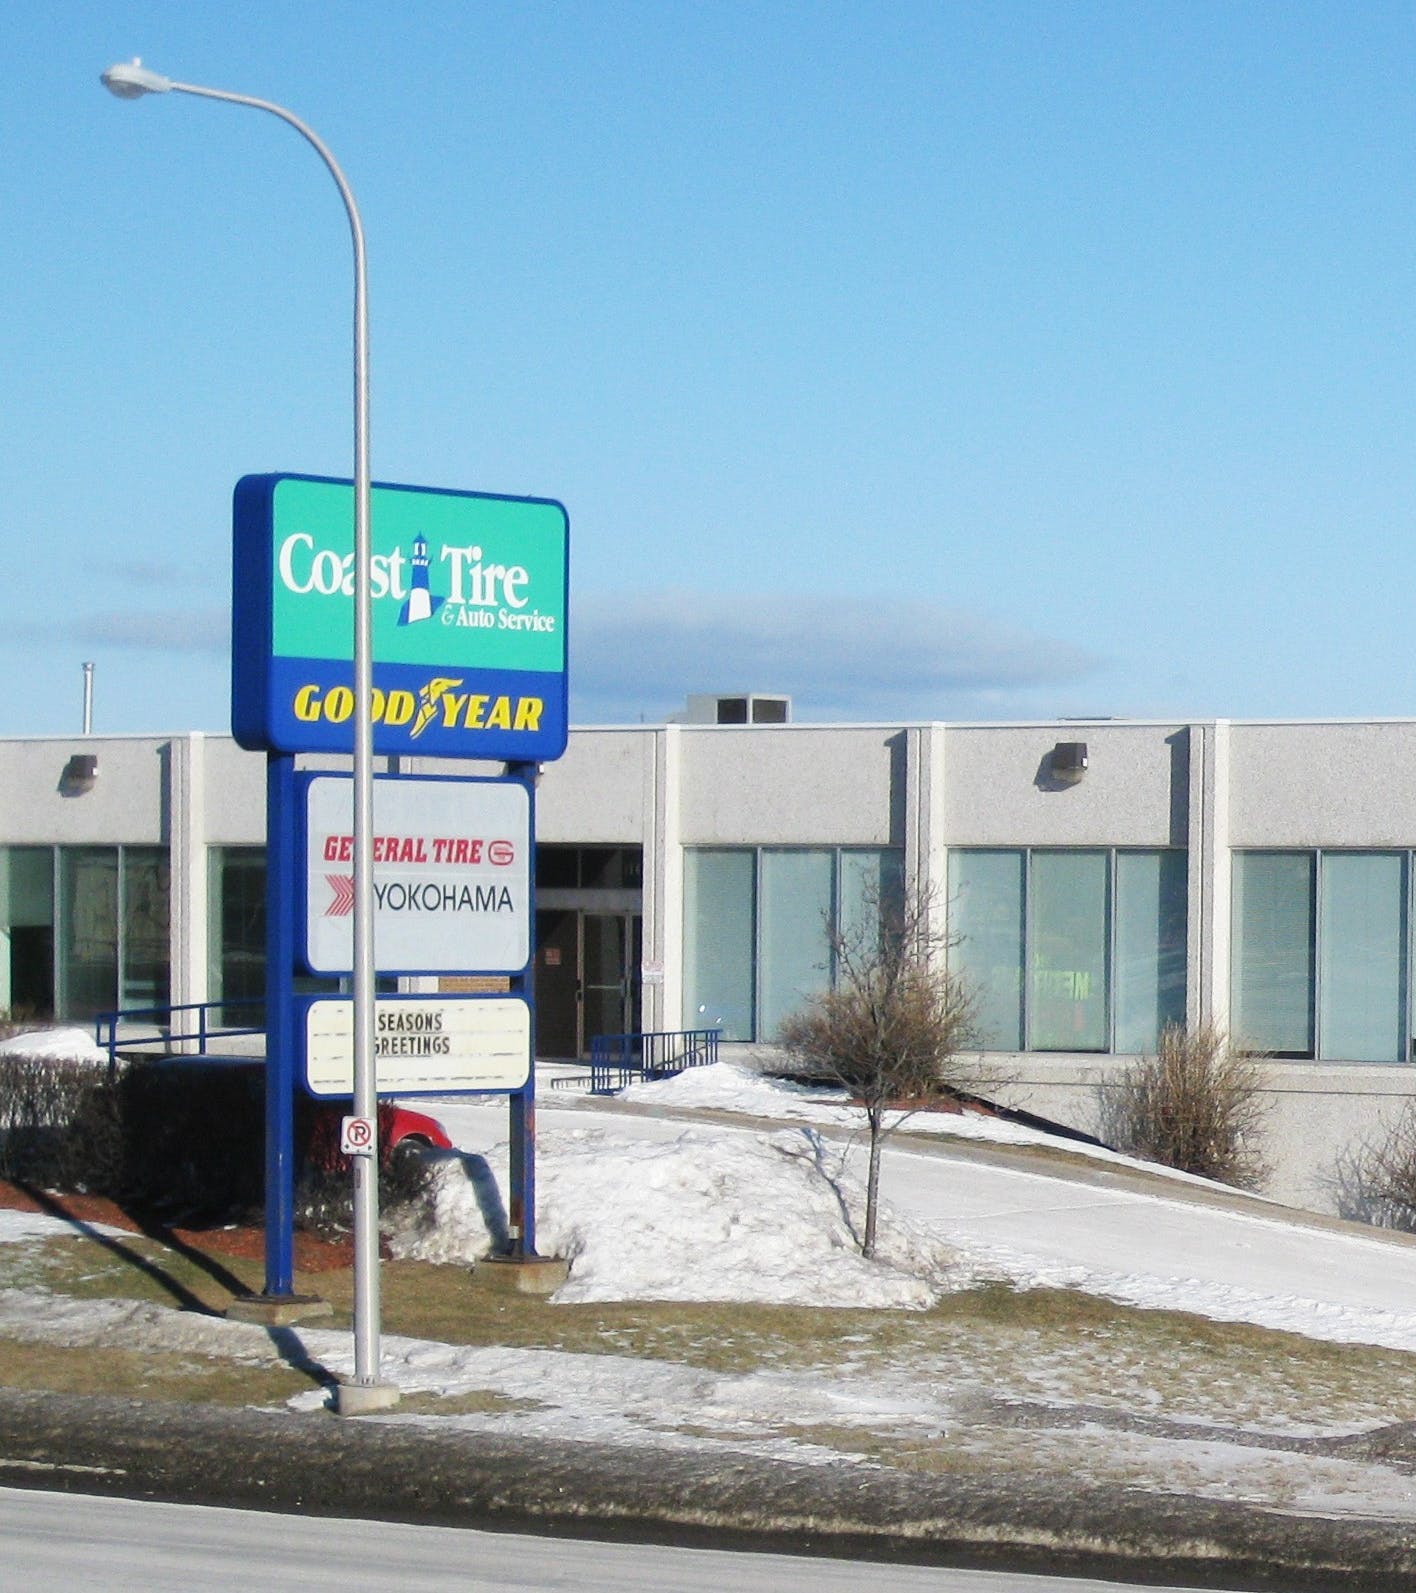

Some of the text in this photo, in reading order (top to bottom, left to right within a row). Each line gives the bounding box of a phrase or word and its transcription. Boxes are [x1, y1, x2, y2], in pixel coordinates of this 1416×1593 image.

[441, 544, 529, 607] Tire
[456, 605, 494, 628] Auto
[498, 607, 554, 632] Service
[324, 836, 427, 863] GEERAL
[433, 839, 483, 864] TIRE
[374, 883, 514, 913] YOKOHAMA
[379, 1013, 442, 1031] SEASONS
